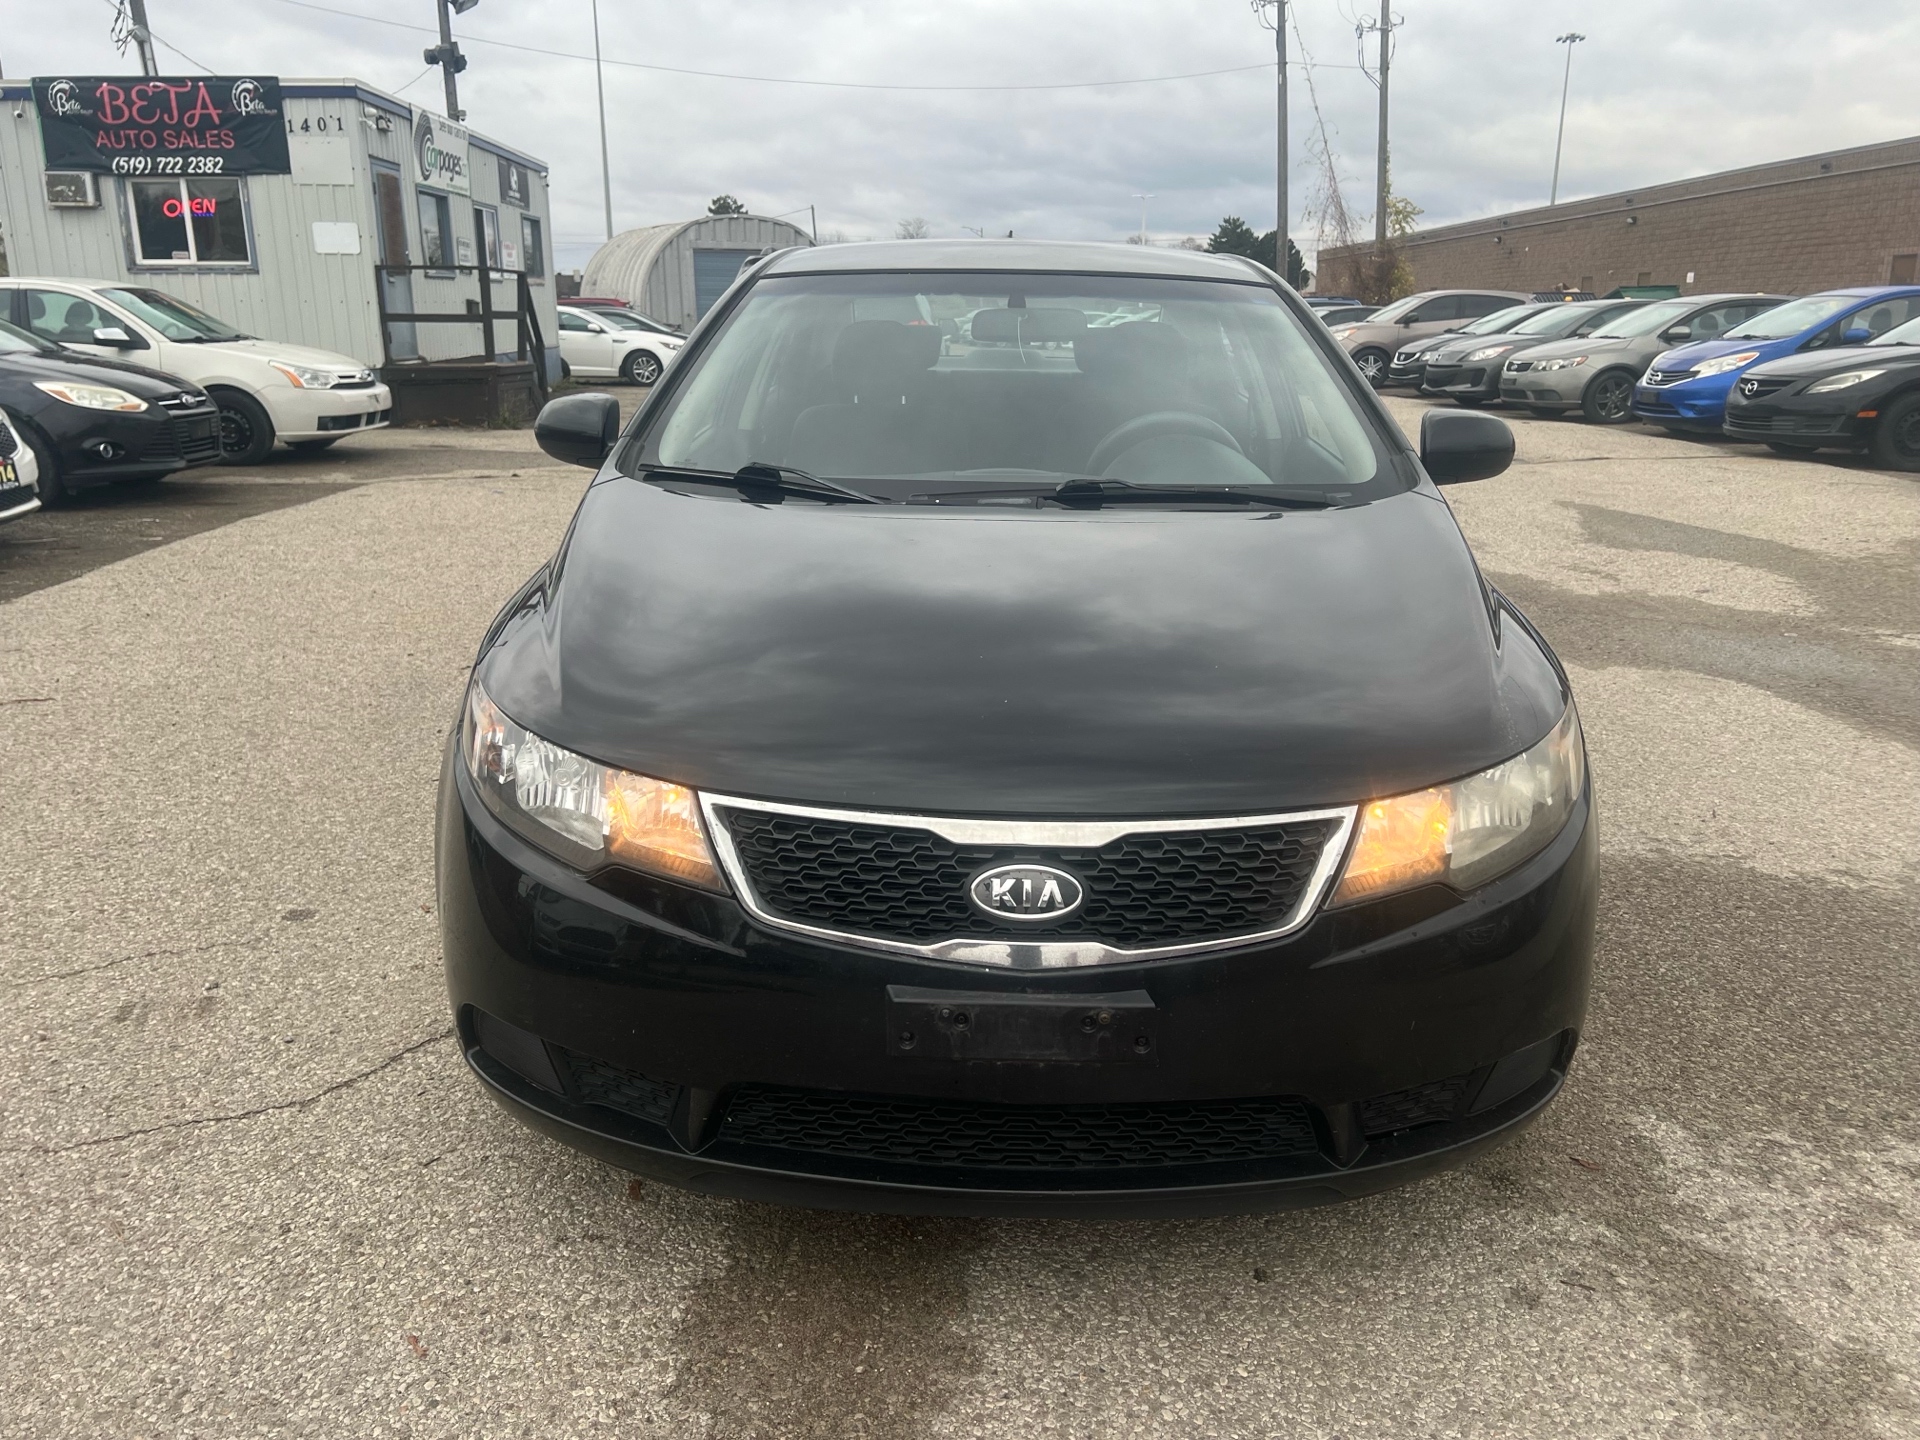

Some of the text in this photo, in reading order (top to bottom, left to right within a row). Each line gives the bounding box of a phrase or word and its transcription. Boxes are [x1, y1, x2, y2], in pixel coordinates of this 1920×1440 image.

[96, 79, 222, 128] BETA
[97, 130, 235, 149] AUTO SALES
[112, 156, 224, 175] (519) 722 2382
[990, 878, 1065, 908] KIA
